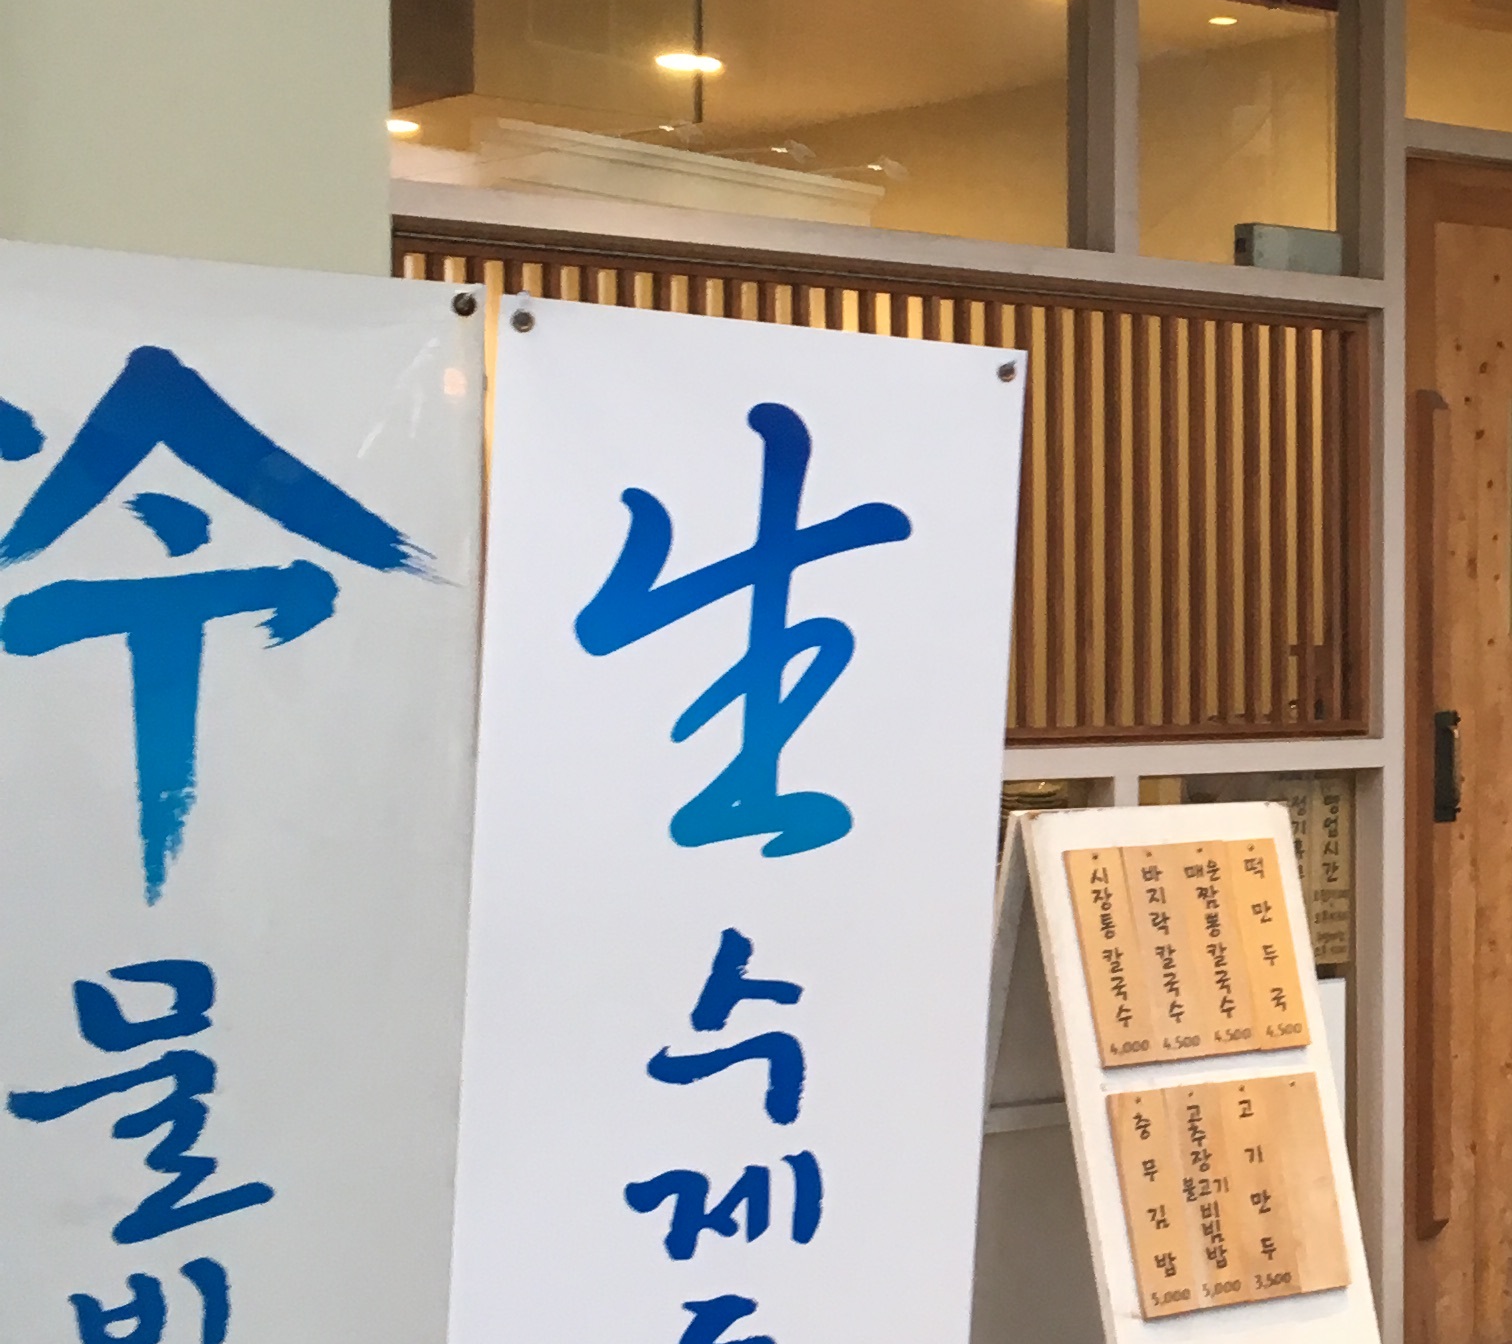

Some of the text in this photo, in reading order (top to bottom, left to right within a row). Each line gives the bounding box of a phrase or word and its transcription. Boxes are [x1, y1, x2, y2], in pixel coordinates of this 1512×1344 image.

[573, 402, 912, 858] 生
[1183, 859, 1221, 882] 매운
[1132, 1112, 1177, 1278] 충무김밥
[1182, 1176, 1230, 1202] 불고기
[1238, 1099, 1278, 1261] 고기만두
